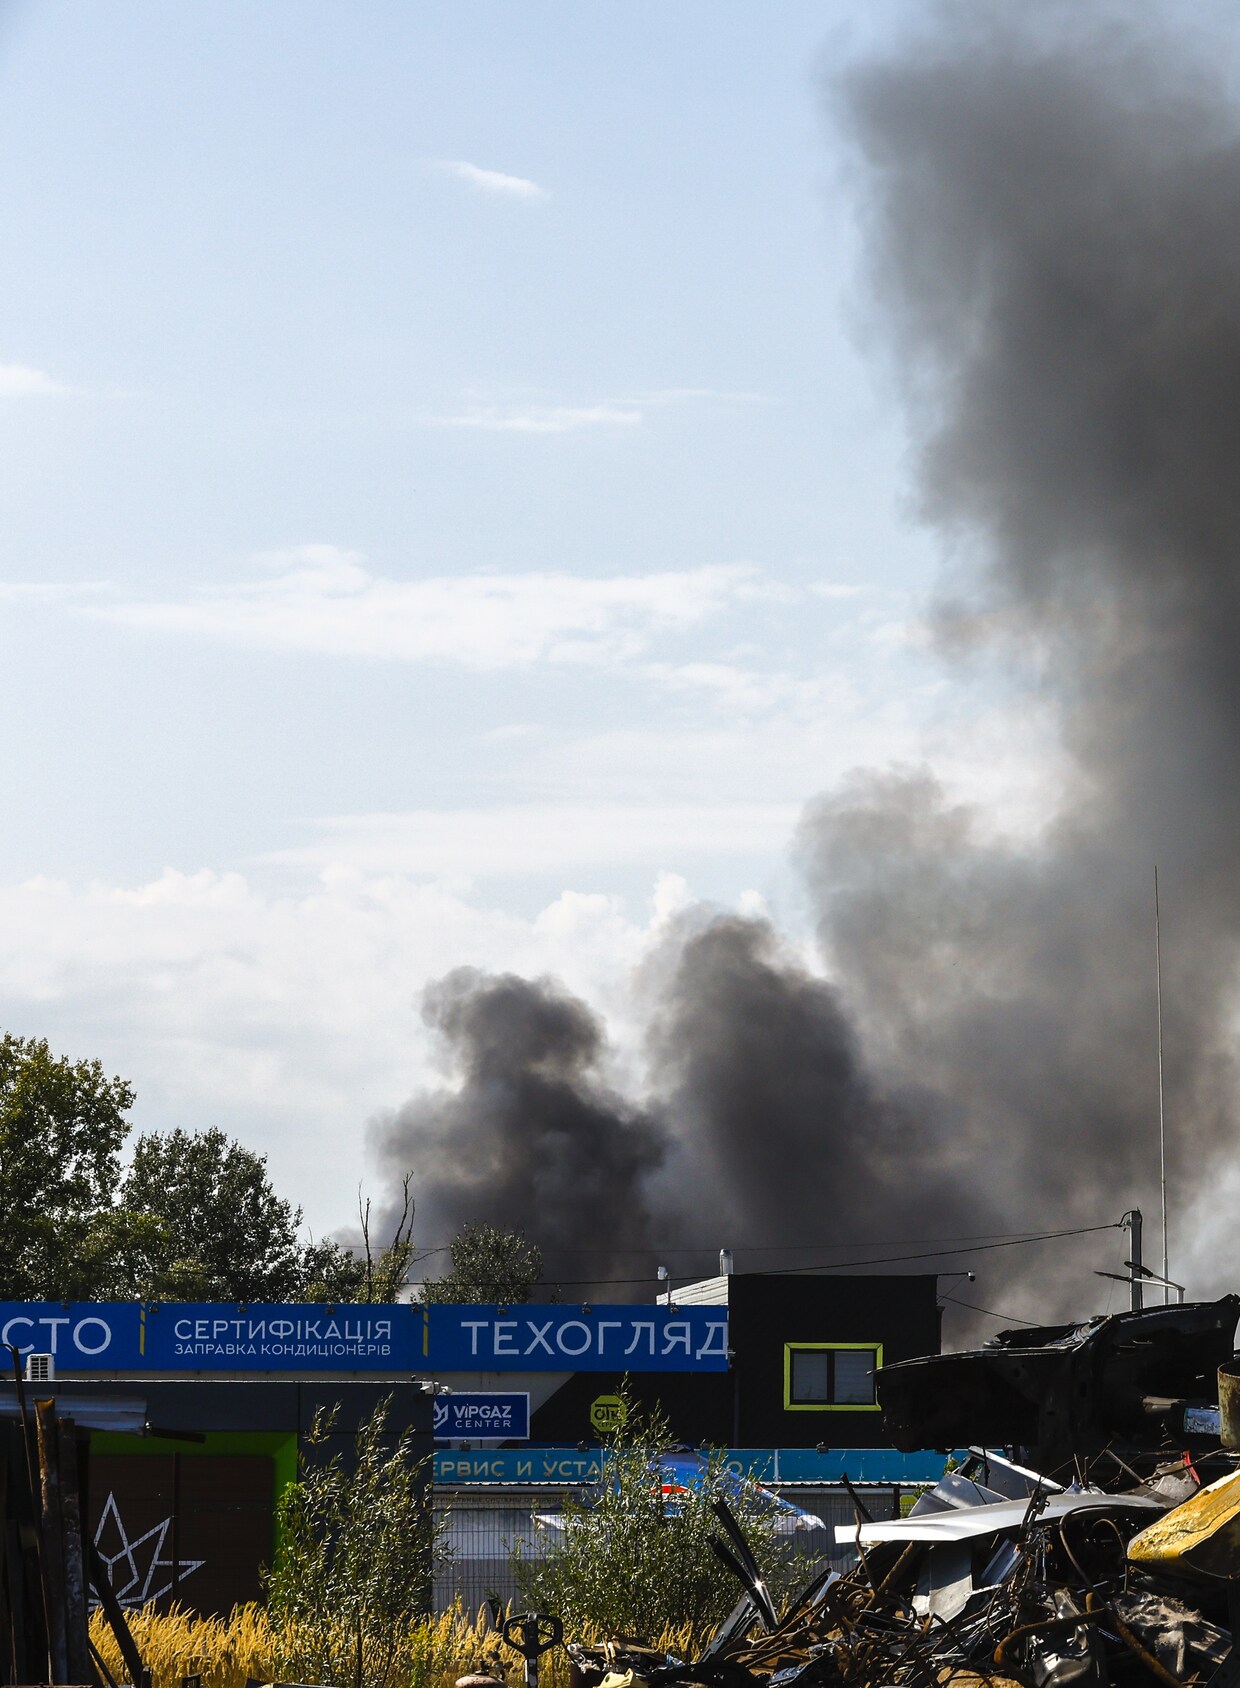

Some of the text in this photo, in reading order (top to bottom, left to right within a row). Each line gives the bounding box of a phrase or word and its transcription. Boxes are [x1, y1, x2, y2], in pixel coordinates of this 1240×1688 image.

[2, 1317, 111, 1354] СТО
[174, 1319, 391, 1343] СЕРТИФІКАЦІЯ
[460, 1321, 728, 1360] ТЕХОГЛЯД
[174, 1343, 391, 1356] ЗАПРАВКА КОНДИЦІОНЕРІВ
[455, 1420, 511, 1428] CENTER
[517, 1461, 532, 1476] И
